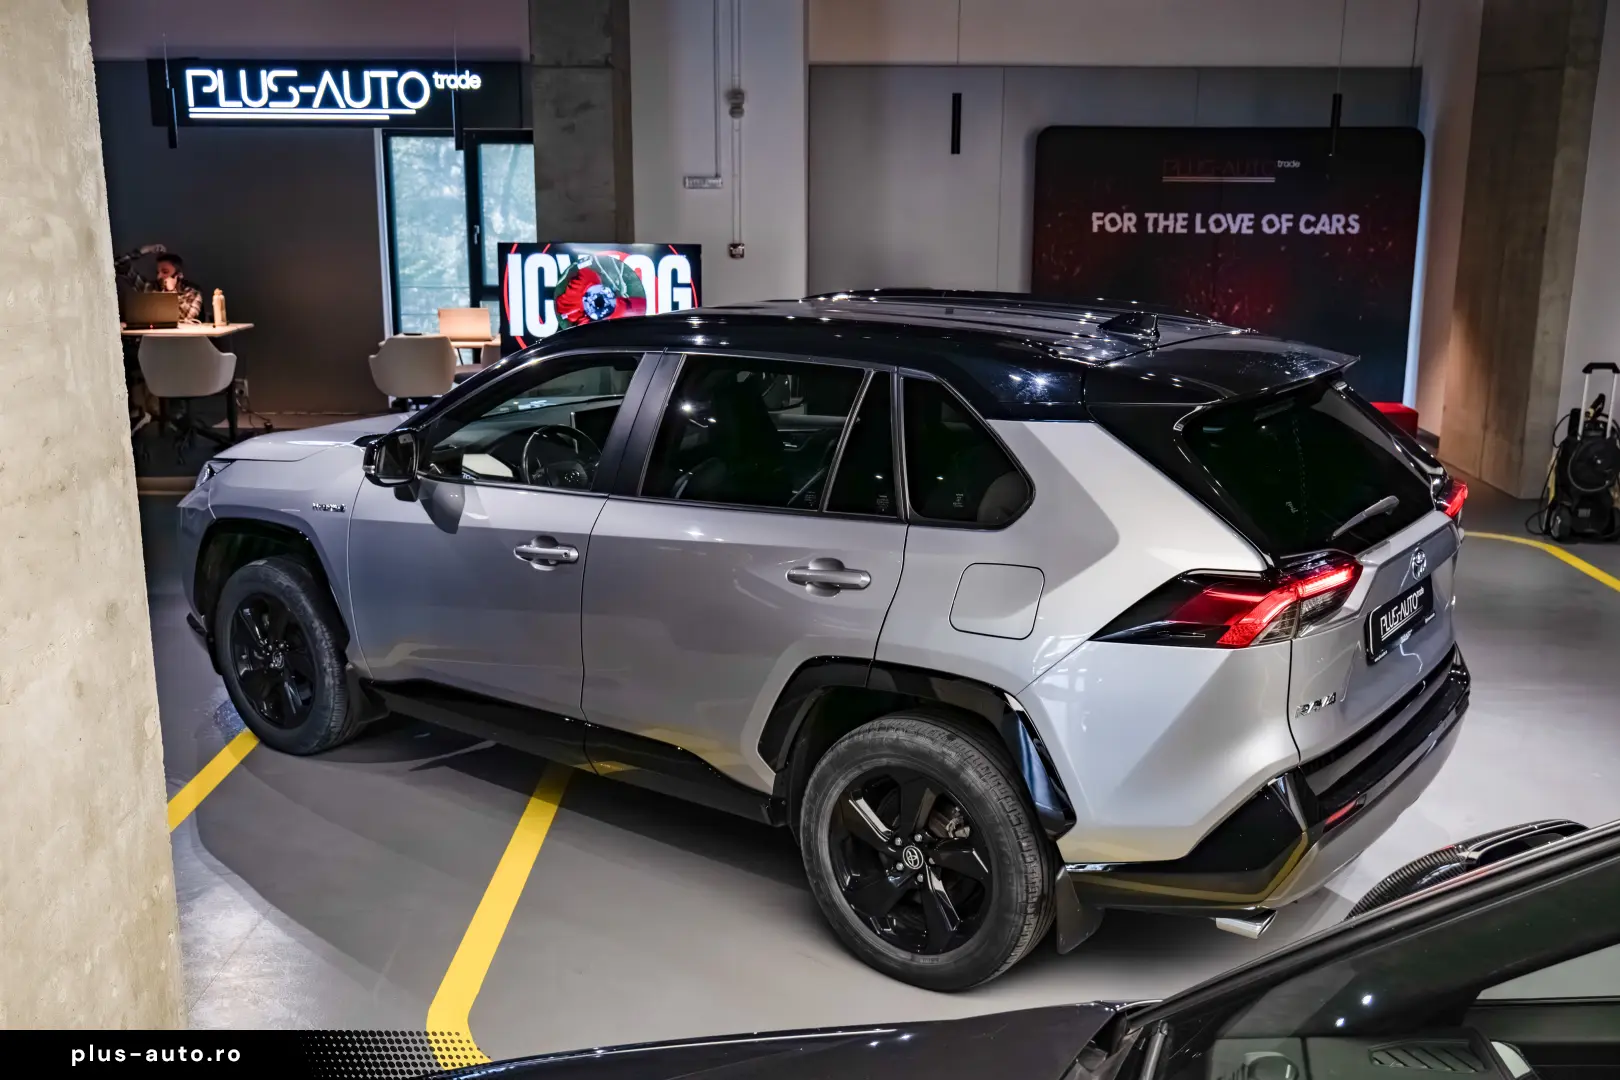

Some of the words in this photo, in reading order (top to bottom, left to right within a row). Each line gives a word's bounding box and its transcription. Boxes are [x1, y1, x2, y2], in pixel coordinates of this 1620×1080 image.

[185, 69, 430, 109] PLUS-AUTO
[432, 70, 482, 90] trade
[1277, 159, 1301, 169] trade
[1091, 212, 1138, 234] FOR
[1144, 212, 1188, 234] THE
[1195, 213, 1254, 235] LOVE
[1260, 213, 1295, 235] OF
[1298, 213, 1361, 235] CARS
